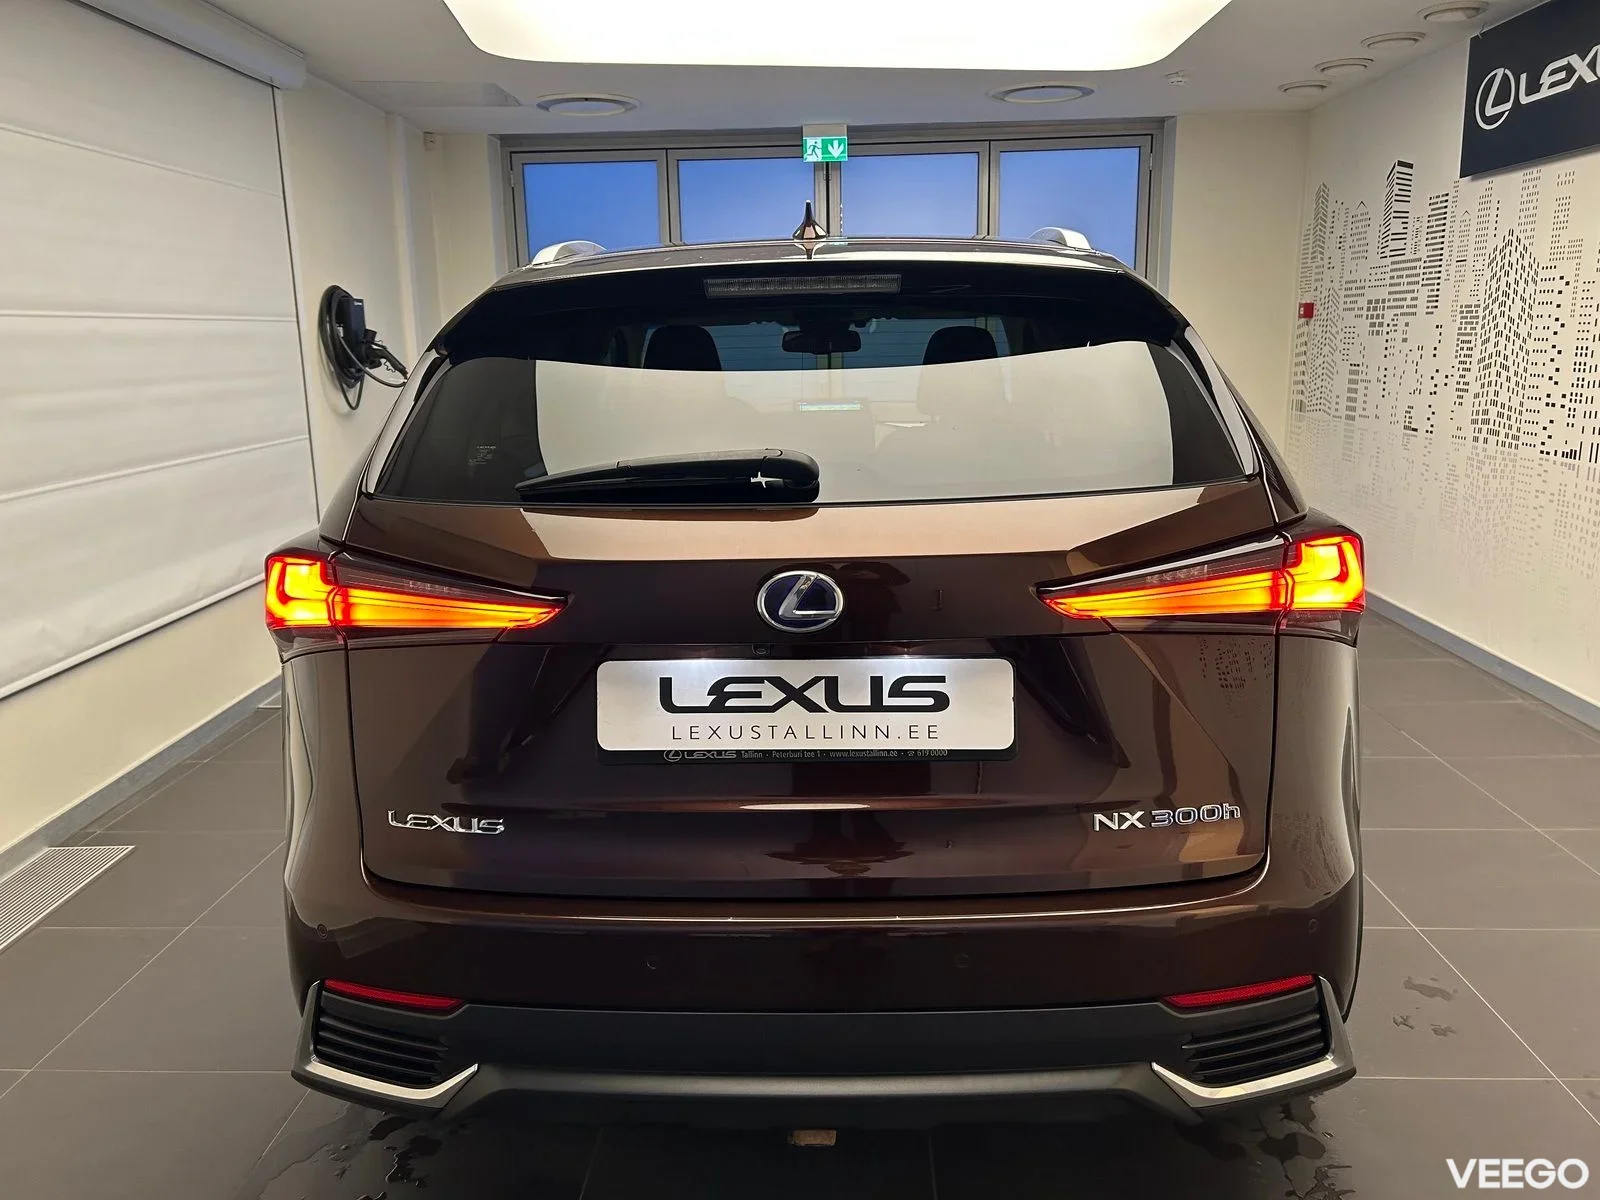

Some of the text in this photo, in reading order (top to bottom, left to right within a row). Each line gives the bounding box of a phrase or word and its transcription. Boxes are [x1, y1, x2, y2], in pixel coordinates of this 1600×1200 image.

[1519, 44, 1600, 105] LEX
[659, 675, 950, 714] LEXUS
[672, 725, 939, 740] LEXUSTALLINN.EE
[684, 751, 737, 759] LEXUS
[741, 750, 763, 759] Tallinn
[772, 750, 803, 759] Peterburi
[829, 749, 898, 758] www.lexustallinn.ee
[388, 810, 505, 835] LEXUS
[1093, 802, 1241, 832] NX 300h
